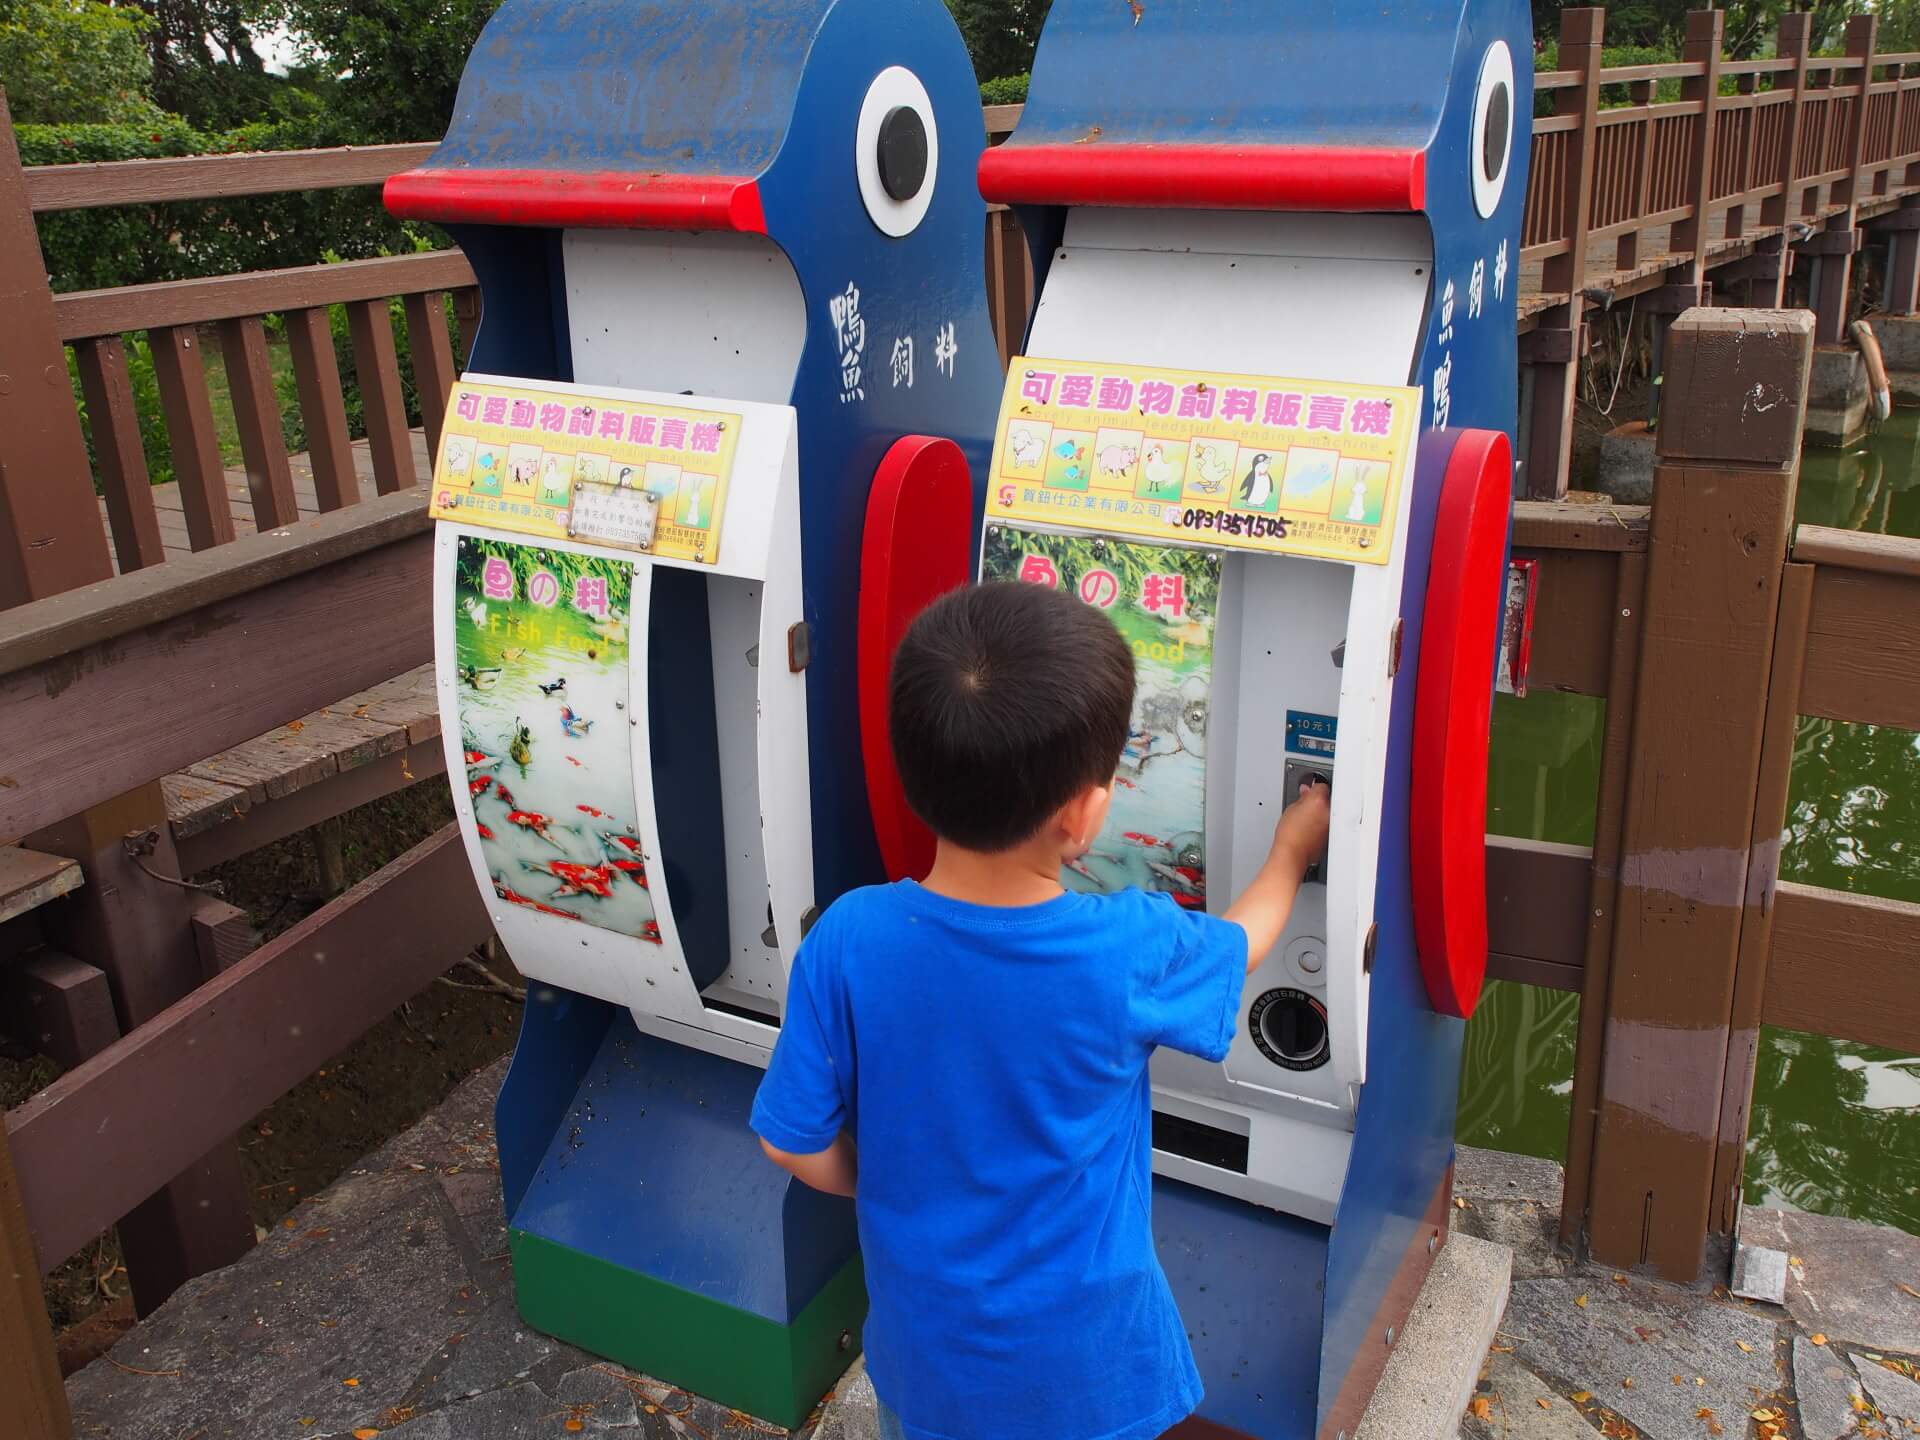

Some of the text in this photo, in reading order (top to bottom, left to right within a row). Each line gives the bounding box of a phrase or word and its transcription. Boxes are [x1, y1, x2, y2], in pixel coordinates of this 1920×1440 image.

[456, 392, 722, 453] 可愛動物飼料販賣機
[1022, 371, 1391, 435] 可愛動物飼料販賣機
